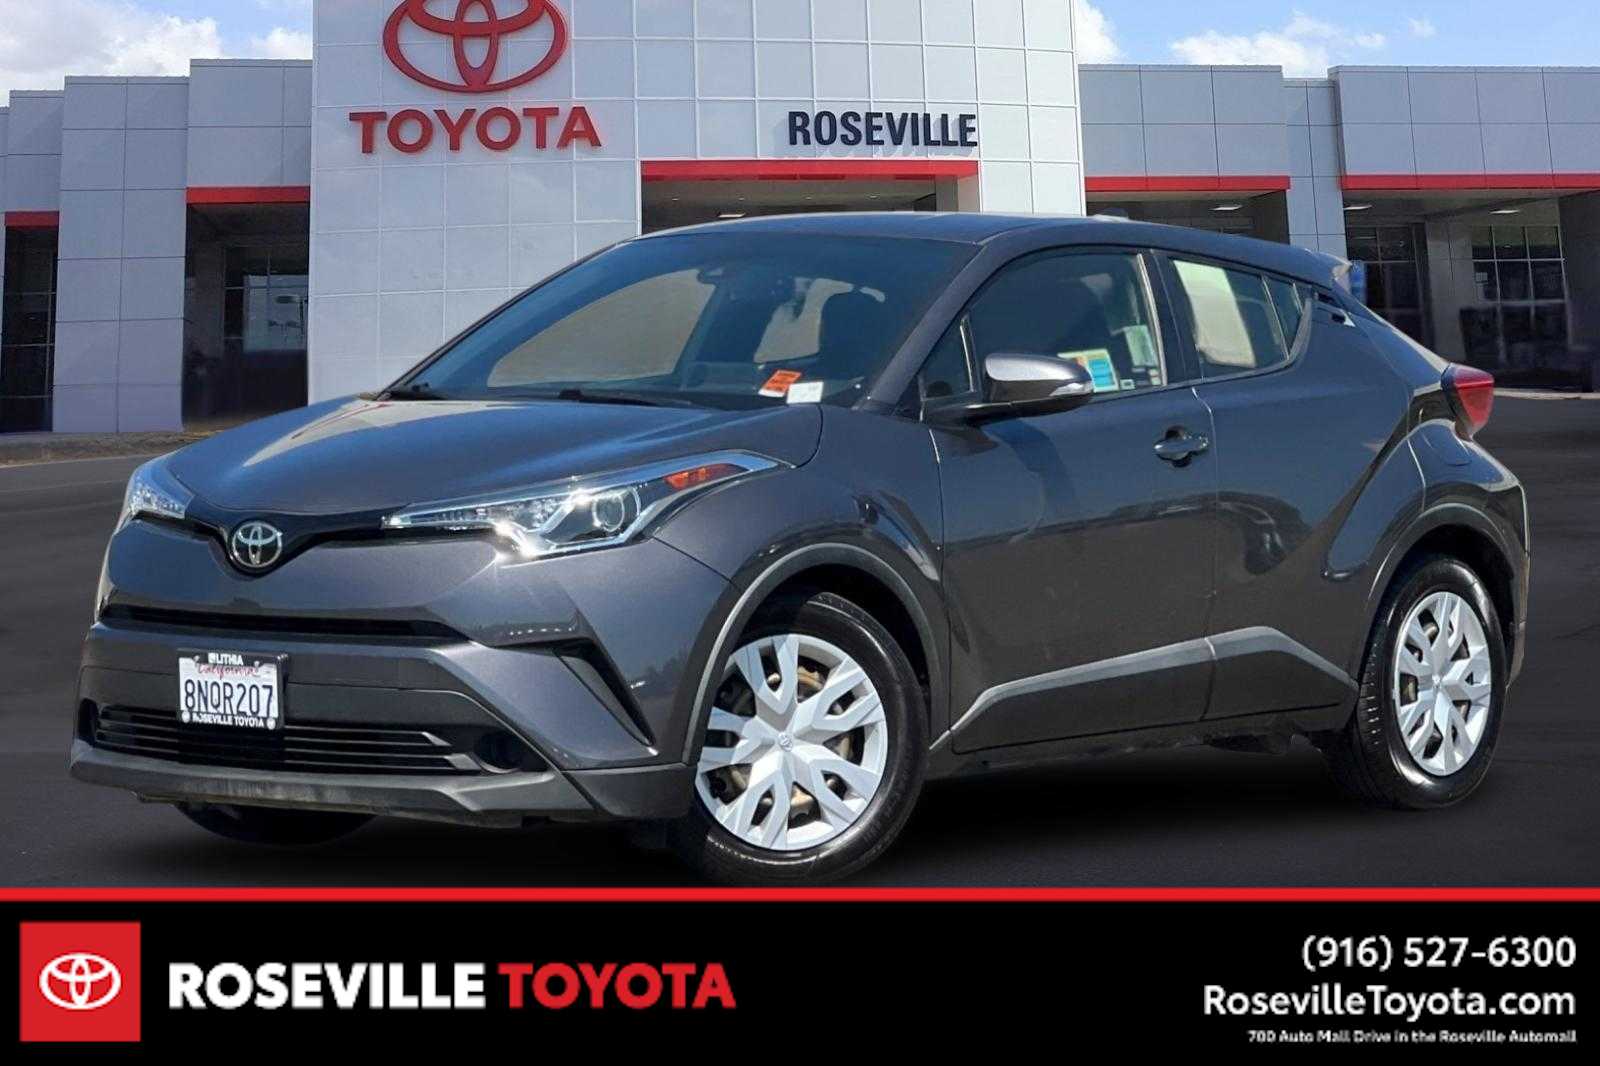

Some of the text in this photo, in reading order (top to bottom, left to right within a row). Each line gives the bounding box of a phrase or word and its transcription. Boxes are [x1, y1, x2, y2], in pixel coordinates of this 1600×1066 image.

[349, 105, 602, 154] TOYOTA
[788, 111, 978, 148] ROSEVILLE
[184, 679, 273, 718] 8NQR207
[192, 712, 265, 729] ROSEVILLE TOYOTA
